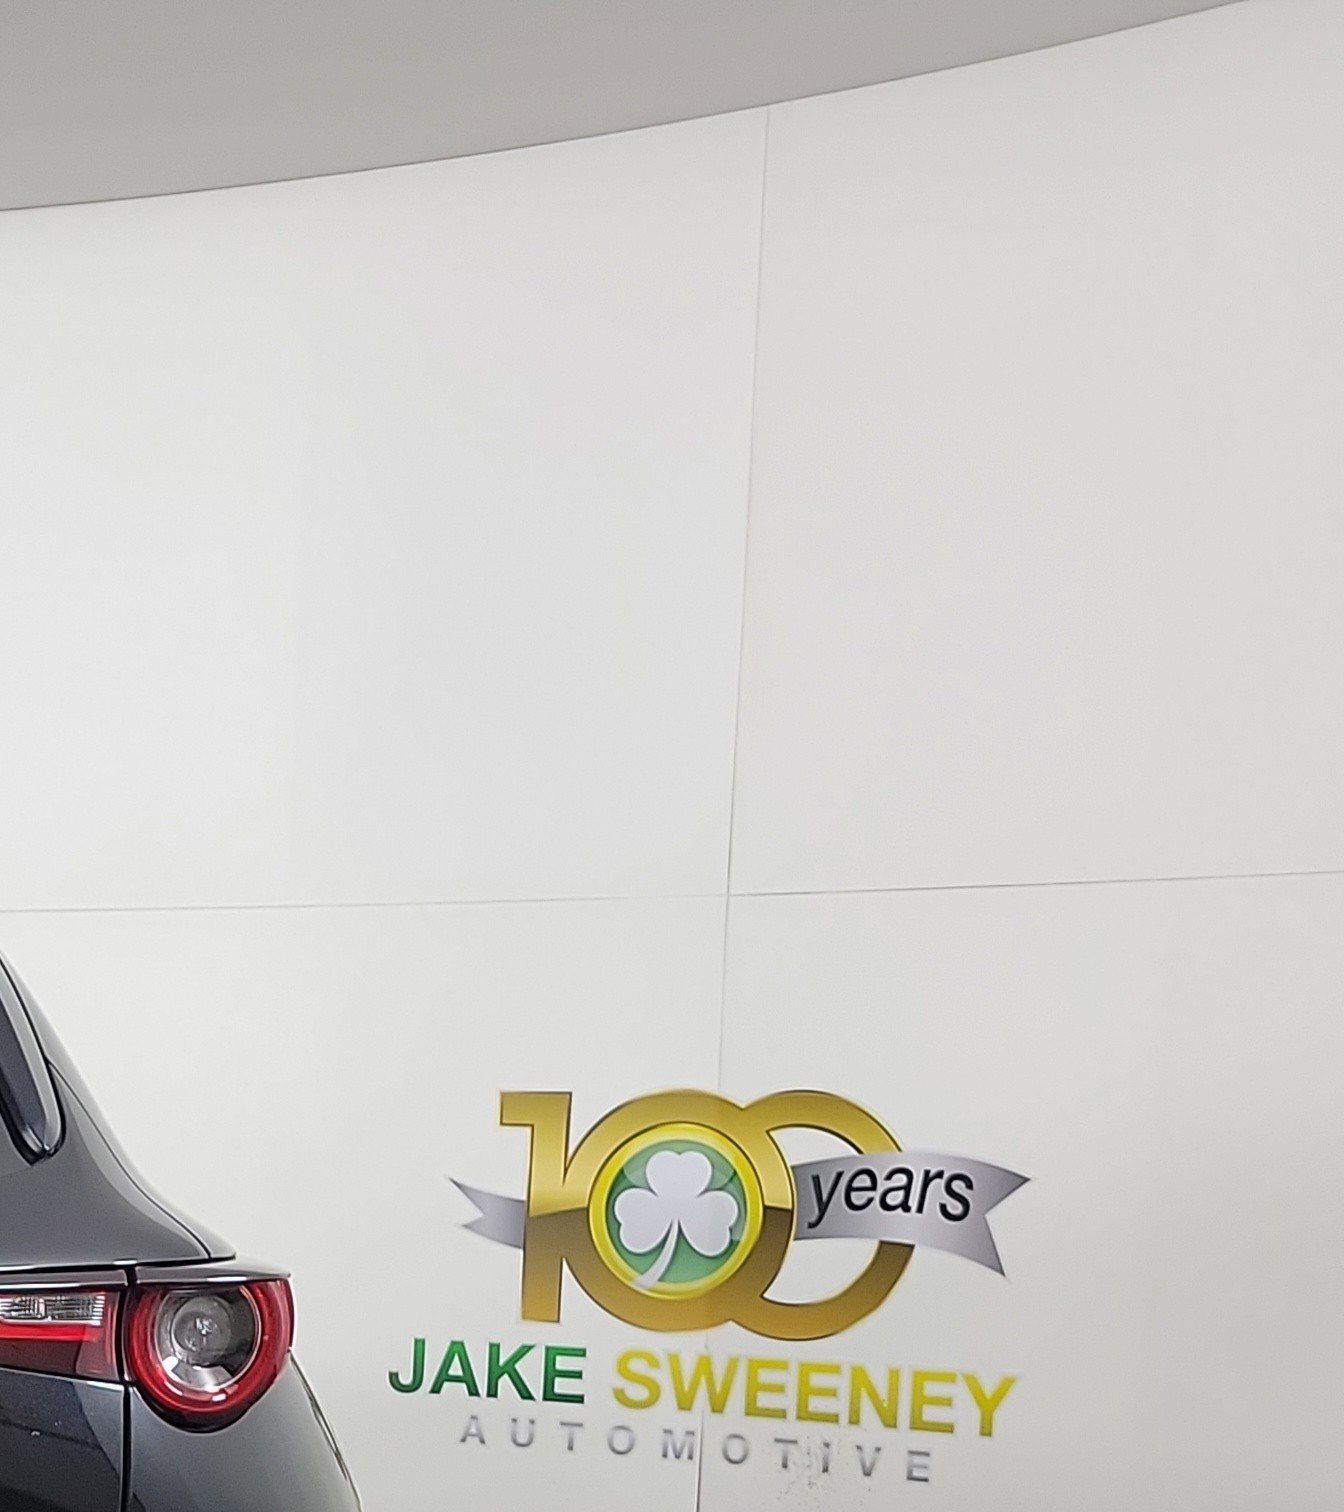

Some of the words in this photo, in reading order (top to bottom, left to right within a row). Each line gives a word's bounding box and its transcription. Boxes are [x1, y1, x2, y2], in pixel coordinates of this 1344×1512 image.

[499, 1088, 915, 1341] 100
[806, 1163, 975, 1230] years
[387, 1336, 588, 1404] JAKE
[612, 1349, 1018, 1438] SWEENEY
[459, 1414, 932, 1483] AUTOMOTIVE
